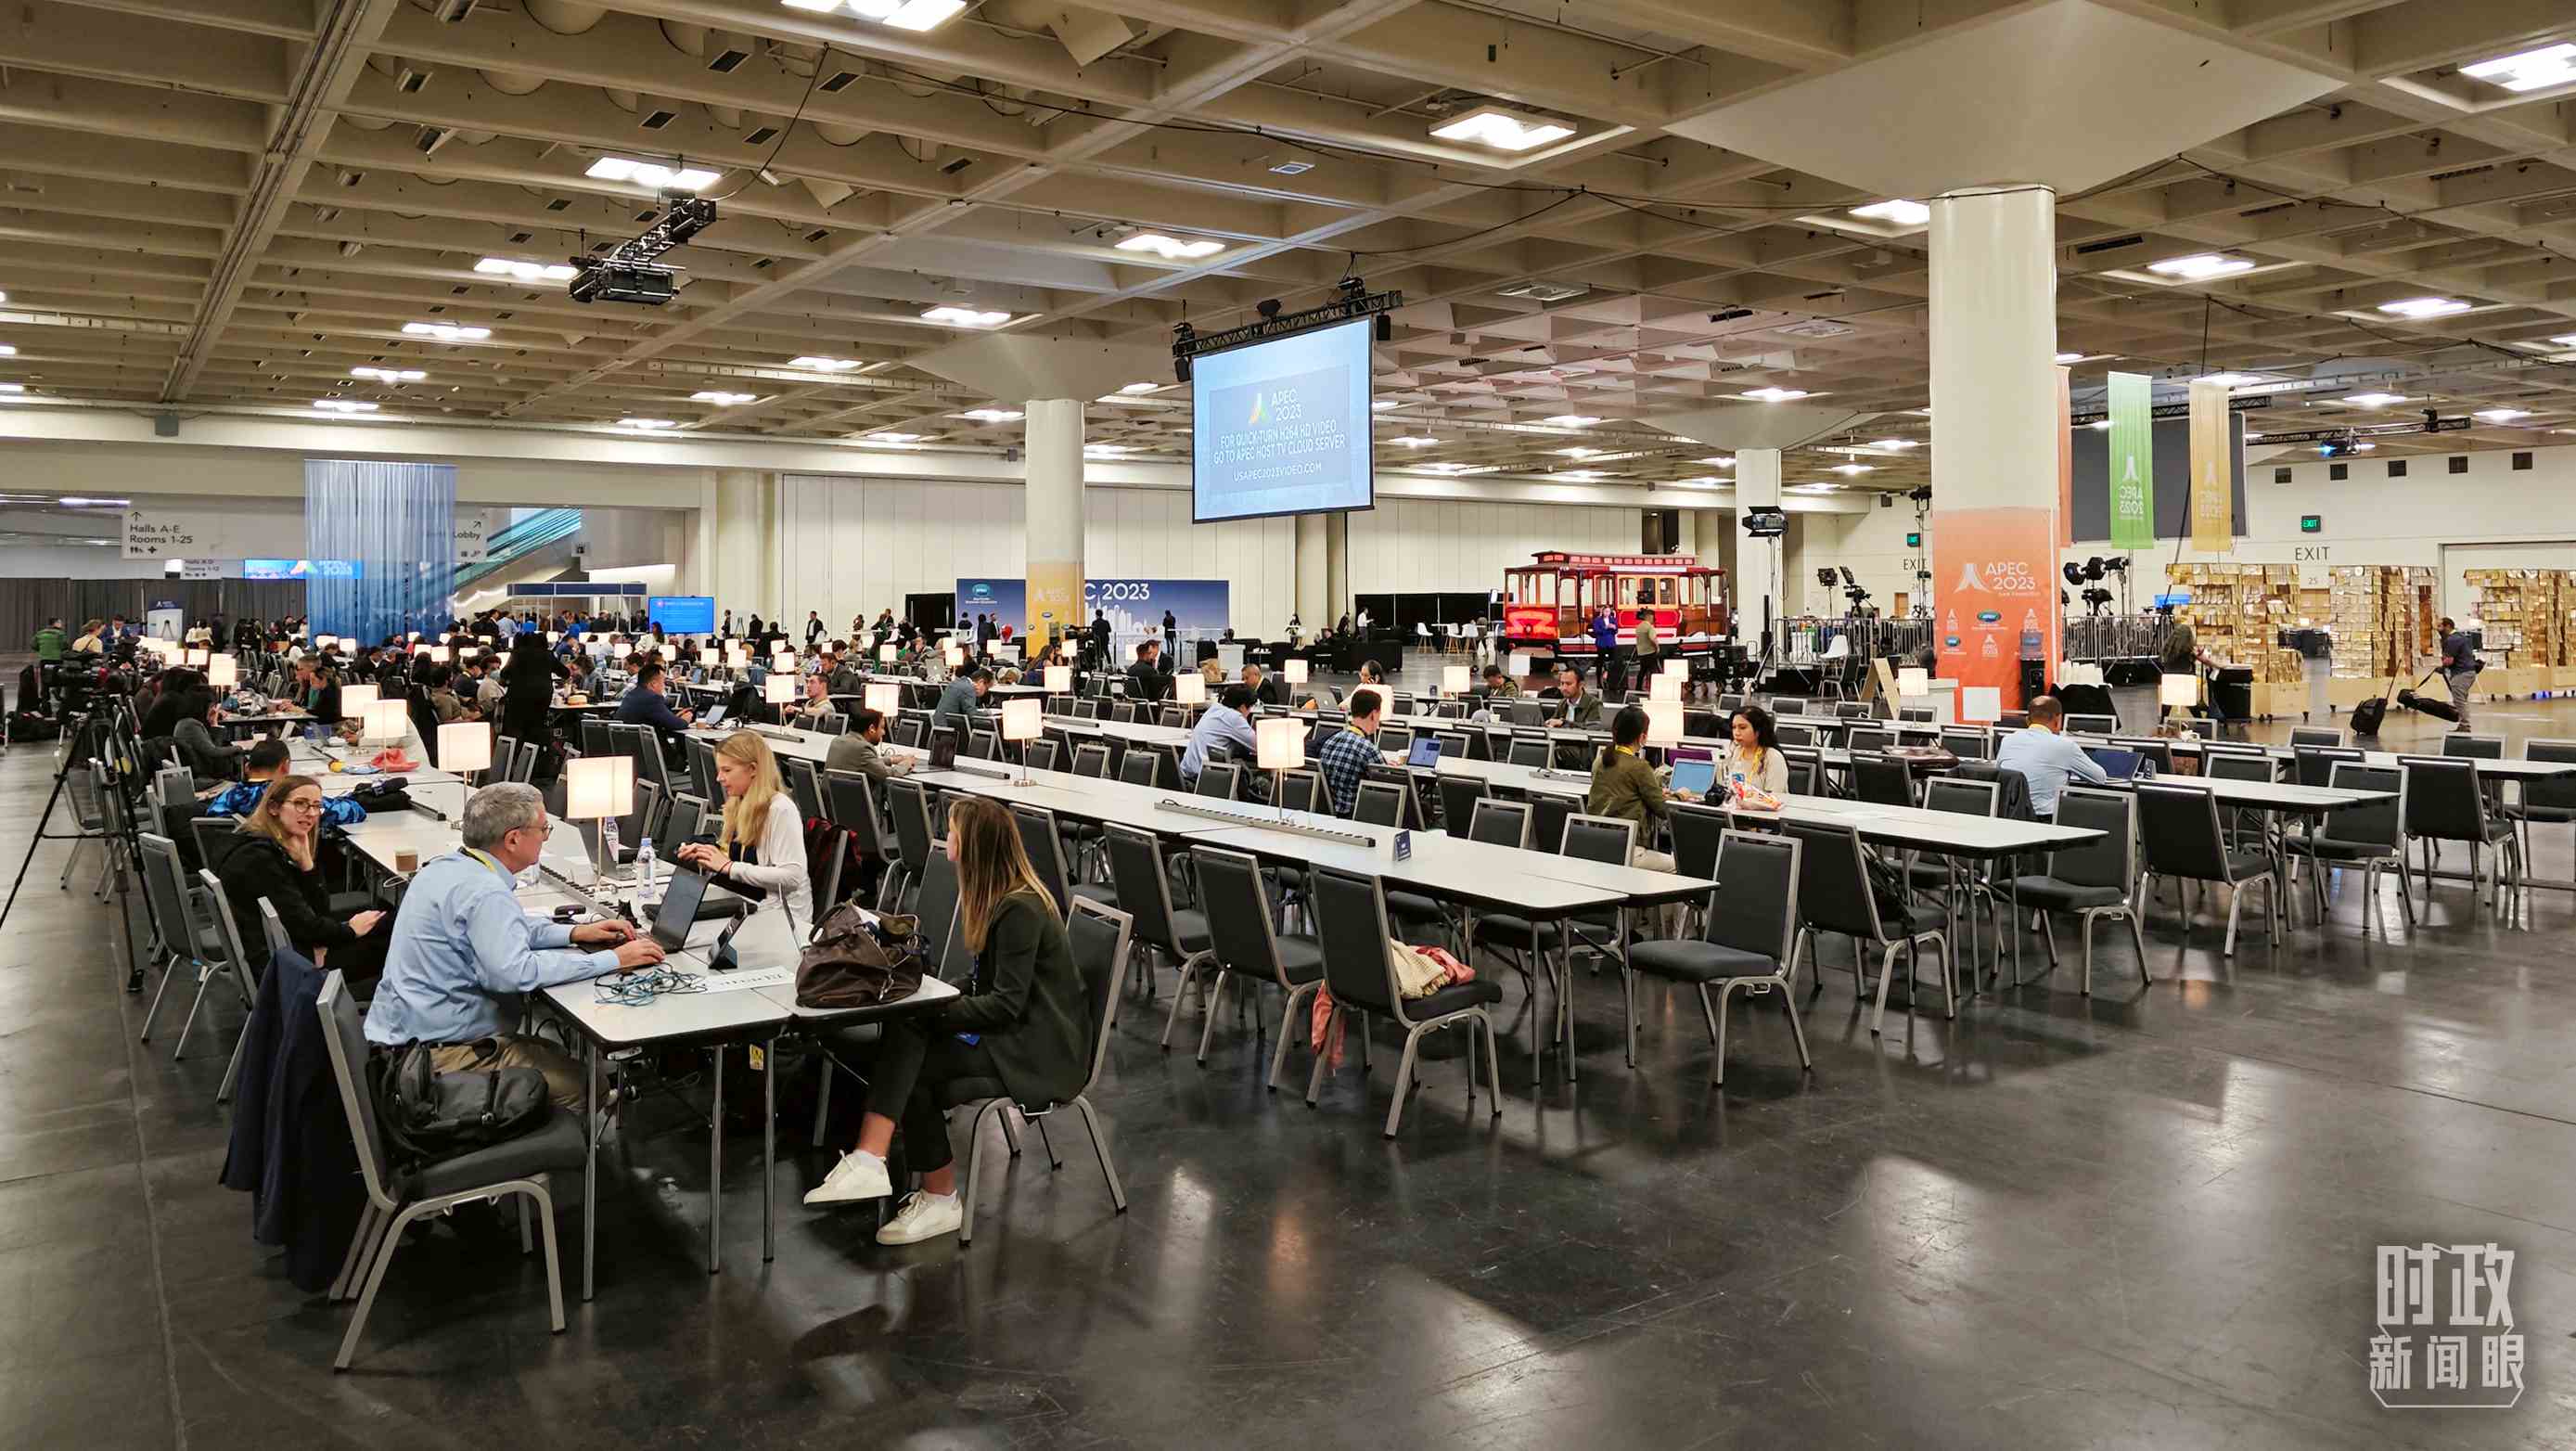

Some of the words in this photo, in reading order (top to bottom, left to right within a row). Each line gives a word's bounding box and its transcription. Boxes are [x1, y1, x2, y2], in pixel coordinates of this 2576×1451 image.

[1270, 388, 1297, 407] APEC
[1275, 403, 1302, 422] 2023
[1220, 434, 1235, 449] FOR
[1312, 418, 1337, 437] VIDEO
[1212, 452, 1224, 465] GO
[1237, 446, 1255, 461] APEC
[1256, 443, 1275, 460] HOST
[1288, 439, 1314, 456] CLOUD
[1315, 434, 1345, 451] SERVER
[130, 524, 156, 533] Halls
[160, 524, 181, 533] A-E
[2301, 519, 2317, 528] EXIT
[130, 534, 167, 544] Rooms
[171, 535, 194, 544] 1-25
[452, 532, 481, 541] Lobby
[2295, 546, 2331, 560] EXIT
[1985, 561, 2030, 576] APEC
[1993, 576, 2036, 590] 2023
[1103, 583, 1150, 601] 2023
